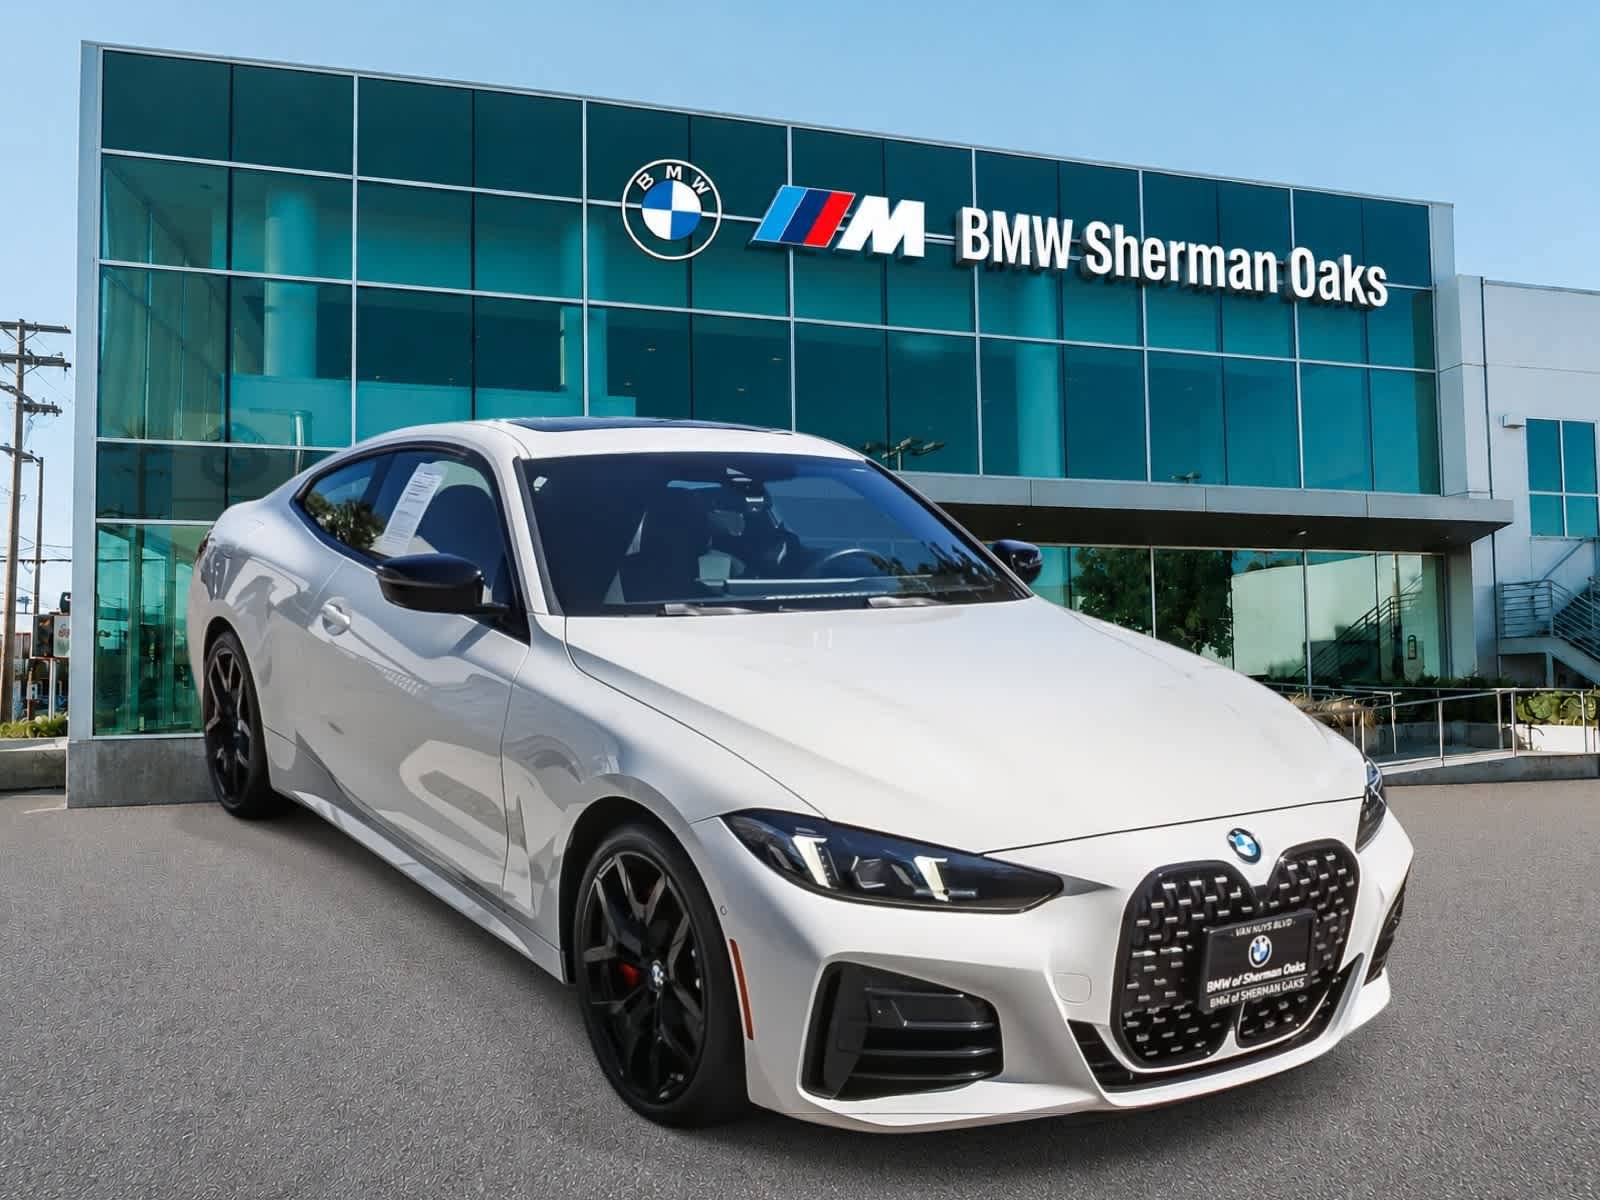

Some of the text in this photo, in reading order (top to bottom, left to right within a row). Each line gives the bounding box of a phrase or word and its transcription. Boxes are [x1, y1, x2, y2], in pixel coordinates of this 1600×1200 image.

[636, 165, 711, 195] BMW
[960, 206, 1389, 308] BMW Sherman Oaks
[1235, 926, 1251, 937] VAN
[1251, 921, 1273, 933] NUYS
[1206, 961, 1306, 993] BMW of Sherman Oaks
[1209, 994, 1231, 1009] BMW
[1231, 991, 1240, 1003] of
[1240, 982, 1281, 1001] SHERMAN
